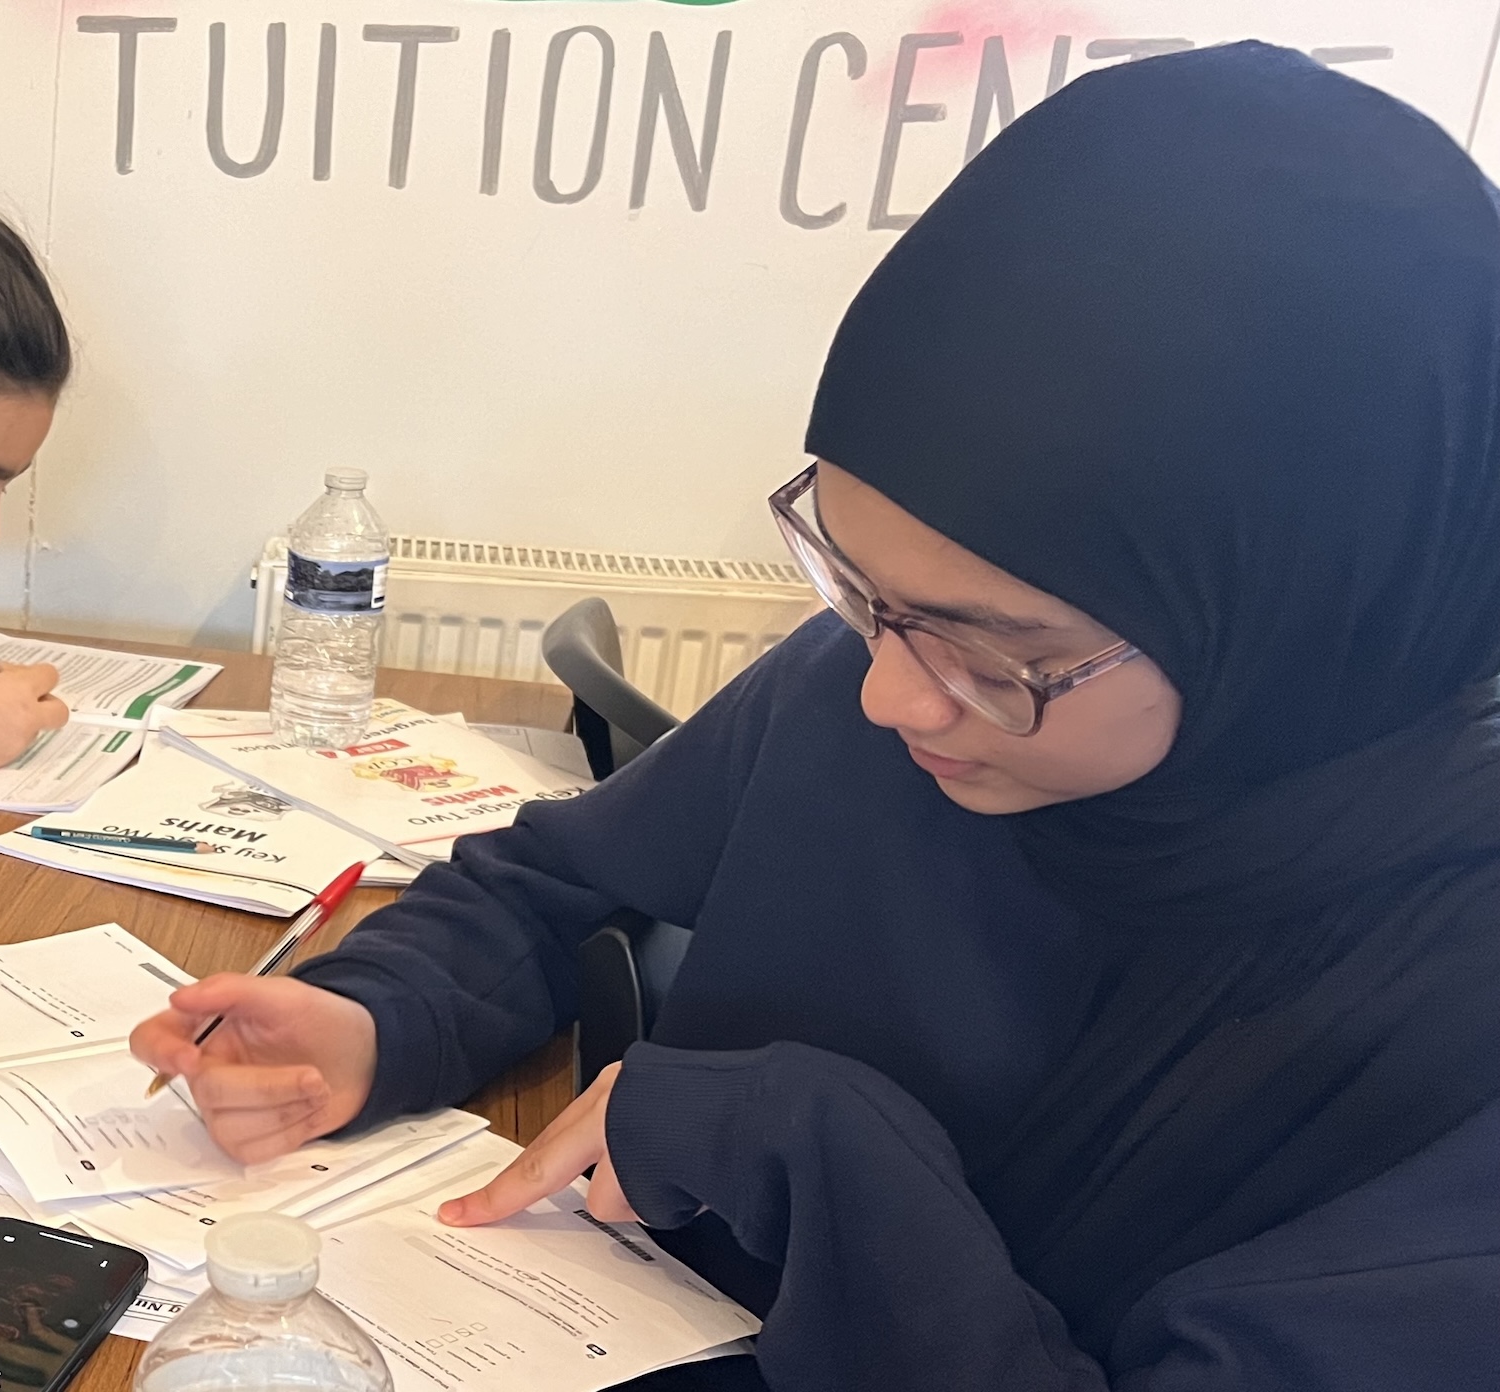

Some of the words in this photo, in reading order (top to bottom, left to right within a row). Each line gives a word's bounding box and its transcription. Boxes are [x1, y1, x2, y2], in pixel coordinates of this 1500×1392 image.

[77, 16, 731, 214] TUITION
[421, 785, 520, 807] Maths
[468, 797, 526, 818] tage
[160, 817, 268, 844] Maths
[235, 847, 287, 864] Key
